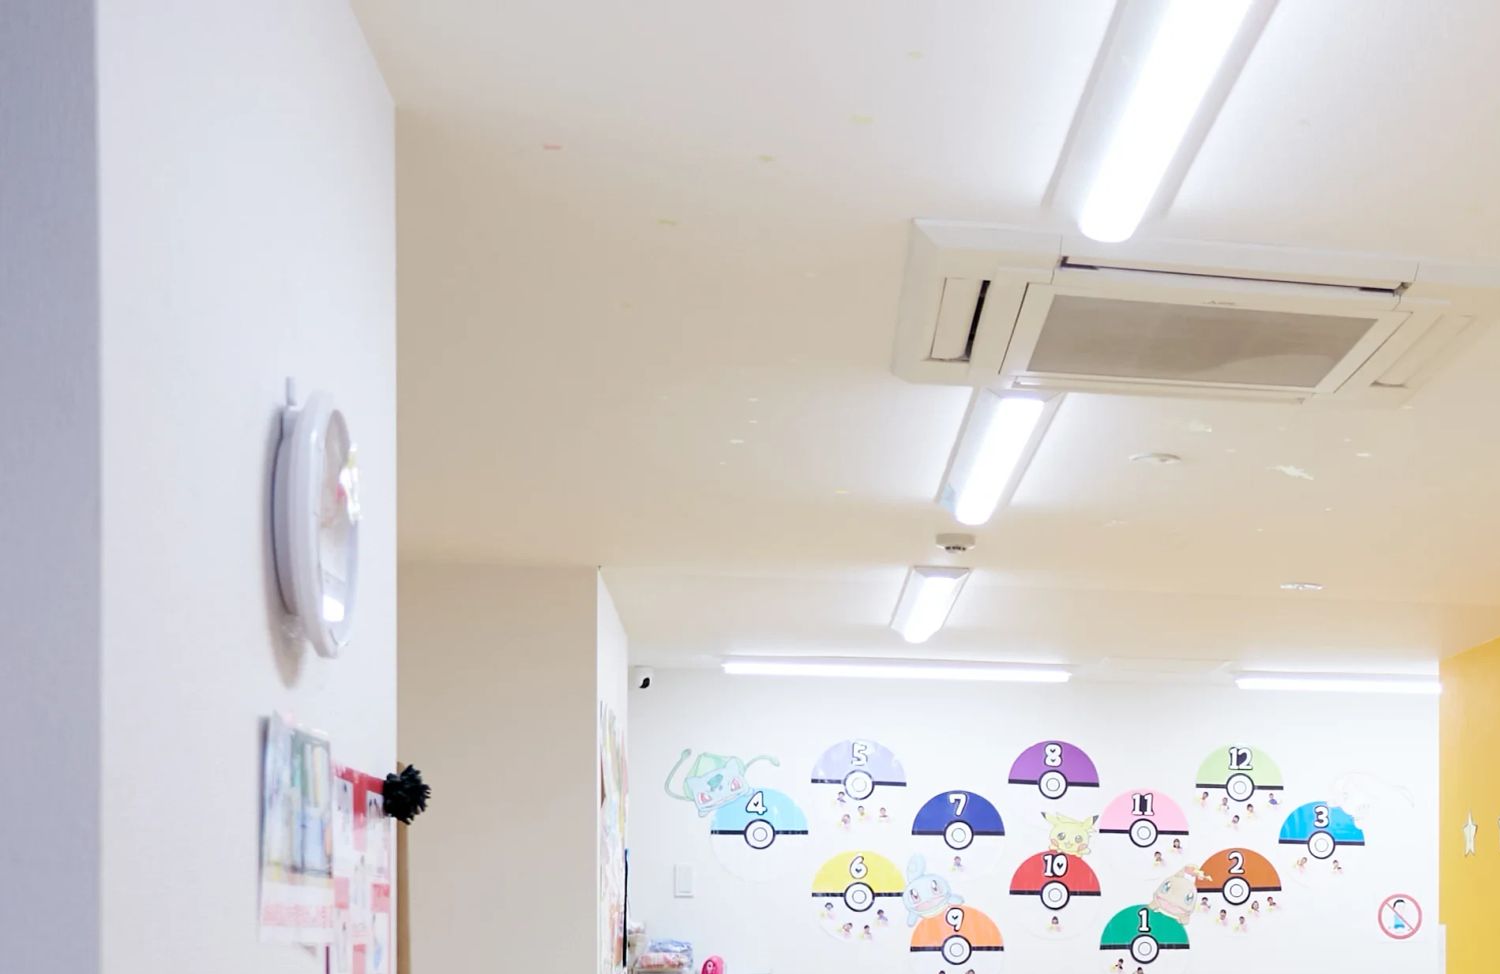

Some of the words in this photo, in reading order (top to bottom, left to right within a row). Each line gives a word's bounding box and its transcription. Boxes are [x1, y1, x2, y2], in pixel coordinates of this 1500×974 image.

[851, 742, 868, 766] 5
[1044, 743, 1063, 767] 8
[1228, 746, 1253, 771] 12
[745, 790, 768, 815] 4
[949, 792, 968, 816] 7
[1131, 792, 1154, 816] 11
[1313, 805, 1330, 828] 3
[849, 856, 868, 879] 6
[1043, 853, 1068, 877] 10
[1228, 849, 1245, 874] 2
[945, 907, 964, 931] 9
[1137, 908, 1151, 933] 1
